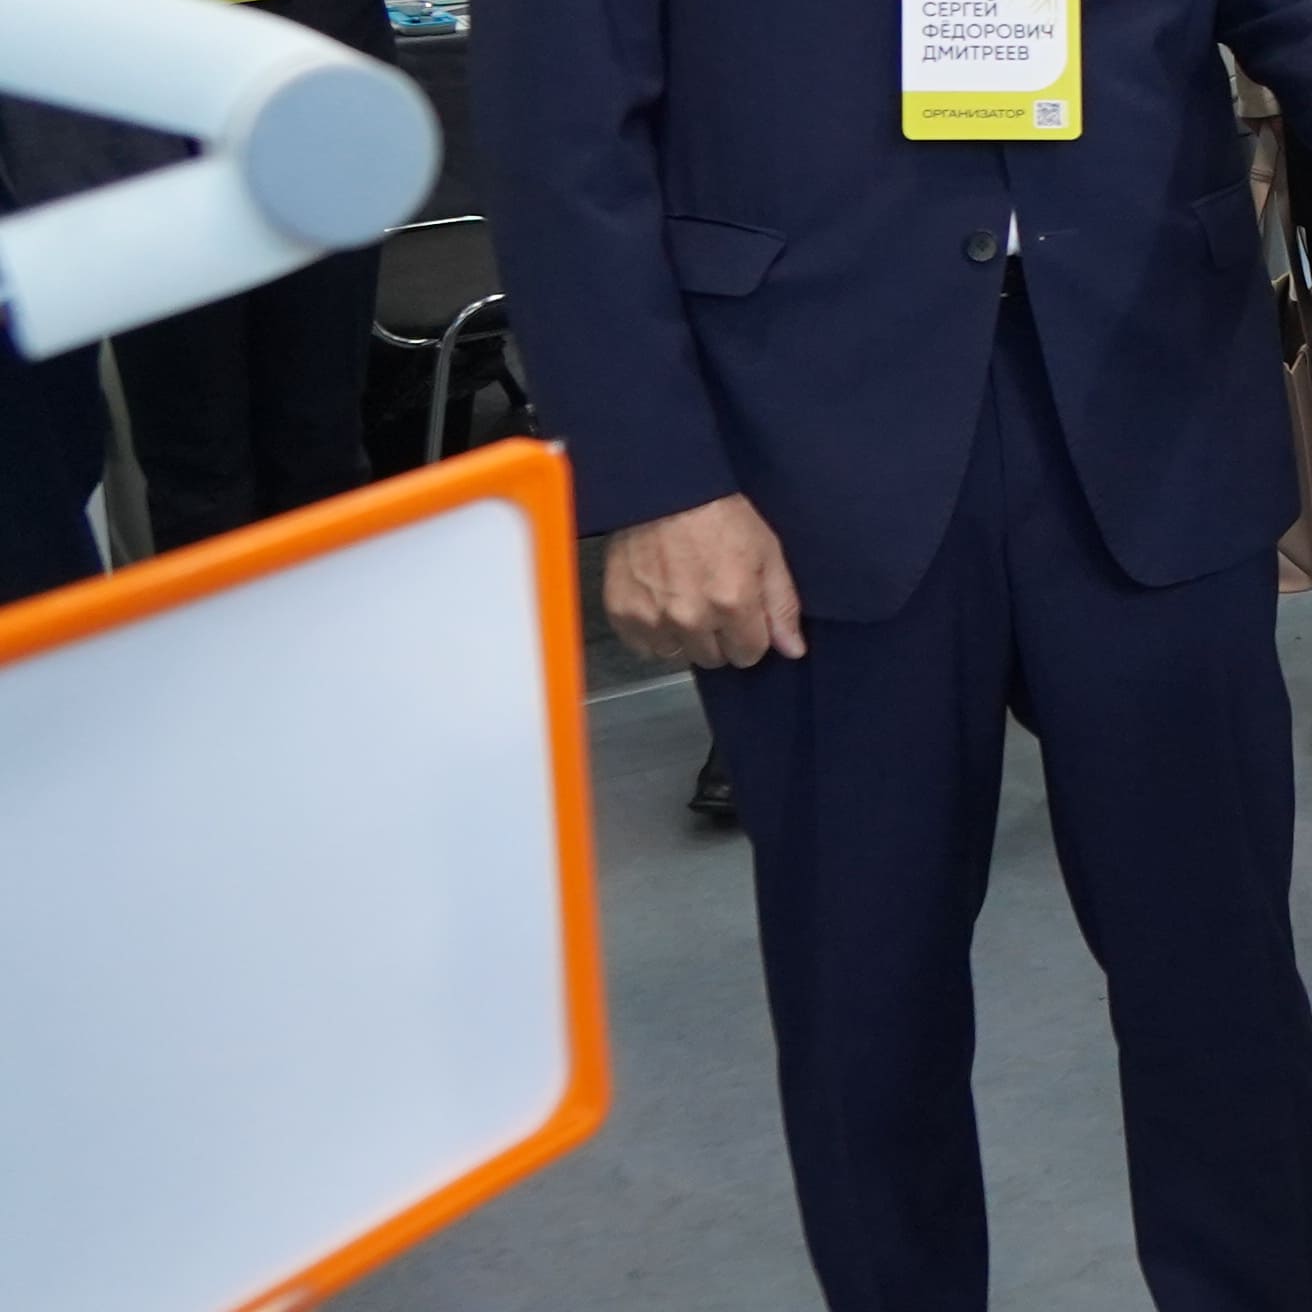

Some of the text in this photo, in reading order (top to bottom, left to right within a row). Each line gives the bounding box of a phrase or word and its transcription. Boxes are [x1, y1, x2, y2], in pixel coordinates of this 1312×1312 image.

[922, 20, 1055, 41] ФЁДОРОВИЧ
[921, 44, 1031, 64] ДМИТРЕЕВ
[922, 107, 1026, 120] ОРГАНИЗАТОР
